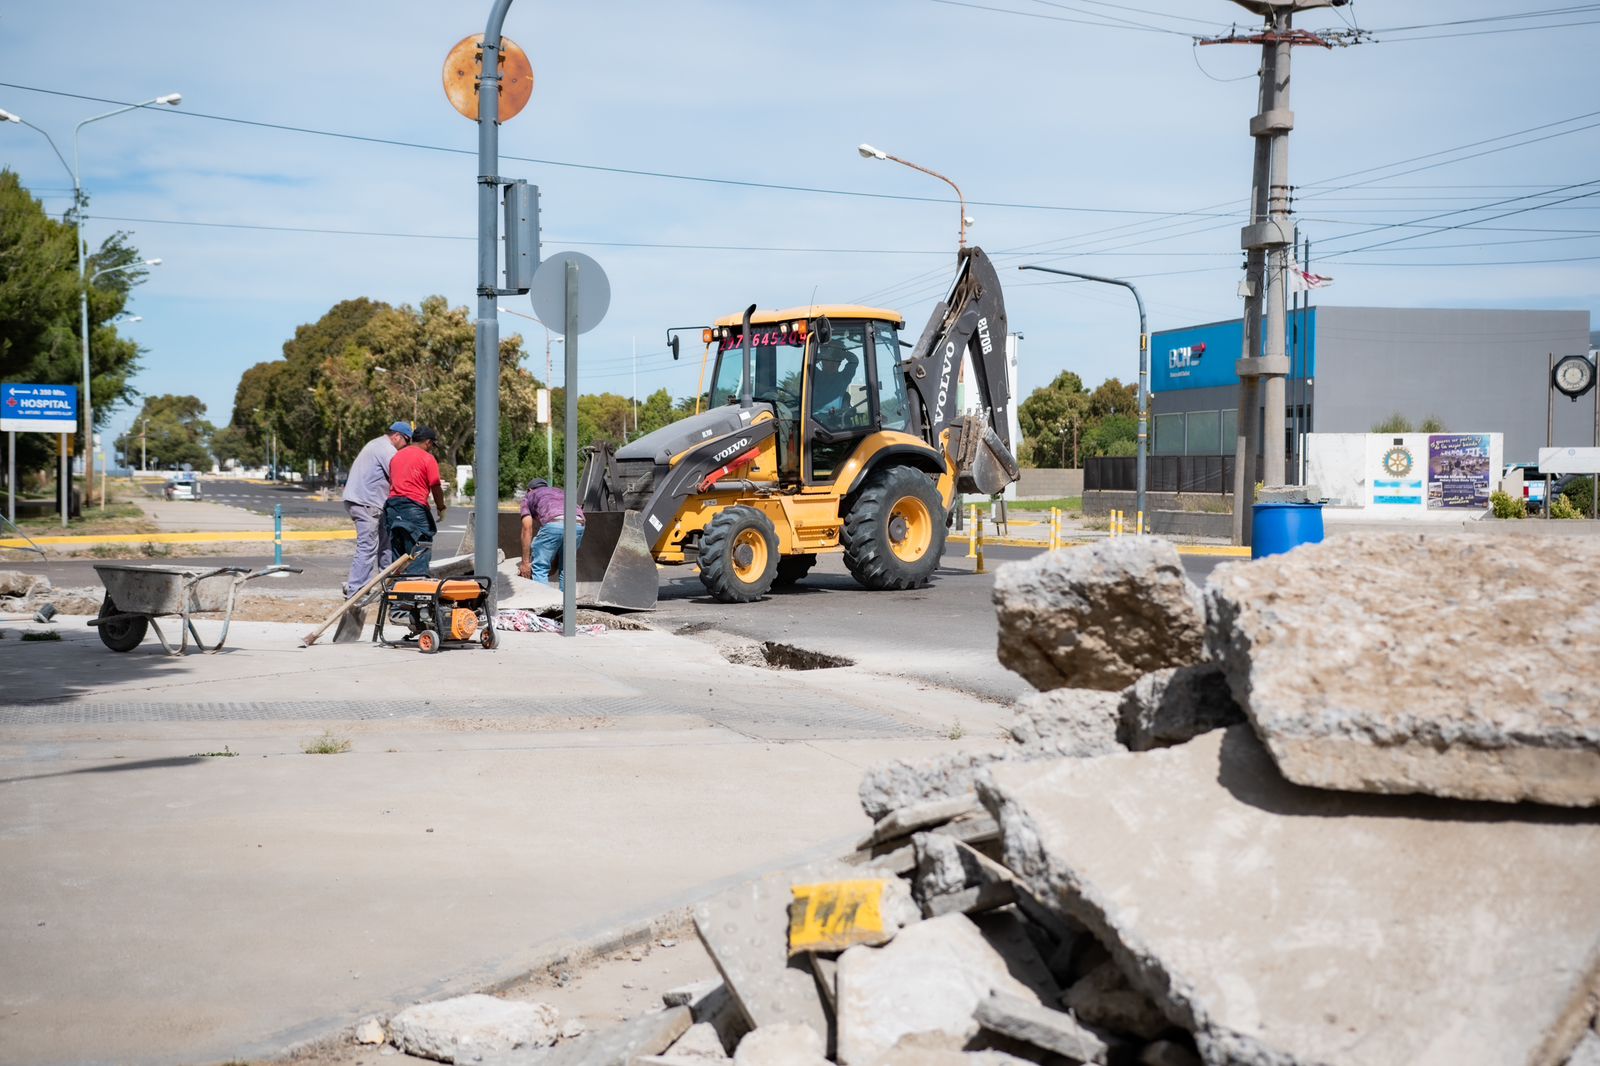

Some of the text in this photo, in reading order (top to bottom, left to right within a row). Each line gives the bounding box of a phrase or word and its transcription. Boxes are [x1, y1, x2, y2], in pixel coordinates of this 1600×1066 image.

[978, 317, 993, 355] BL70B
[934, 341, 955, 426] VOLVO
[20, 399, 72, 409] HOSPITAL
[713, 438, 748, 462] VOLVO
